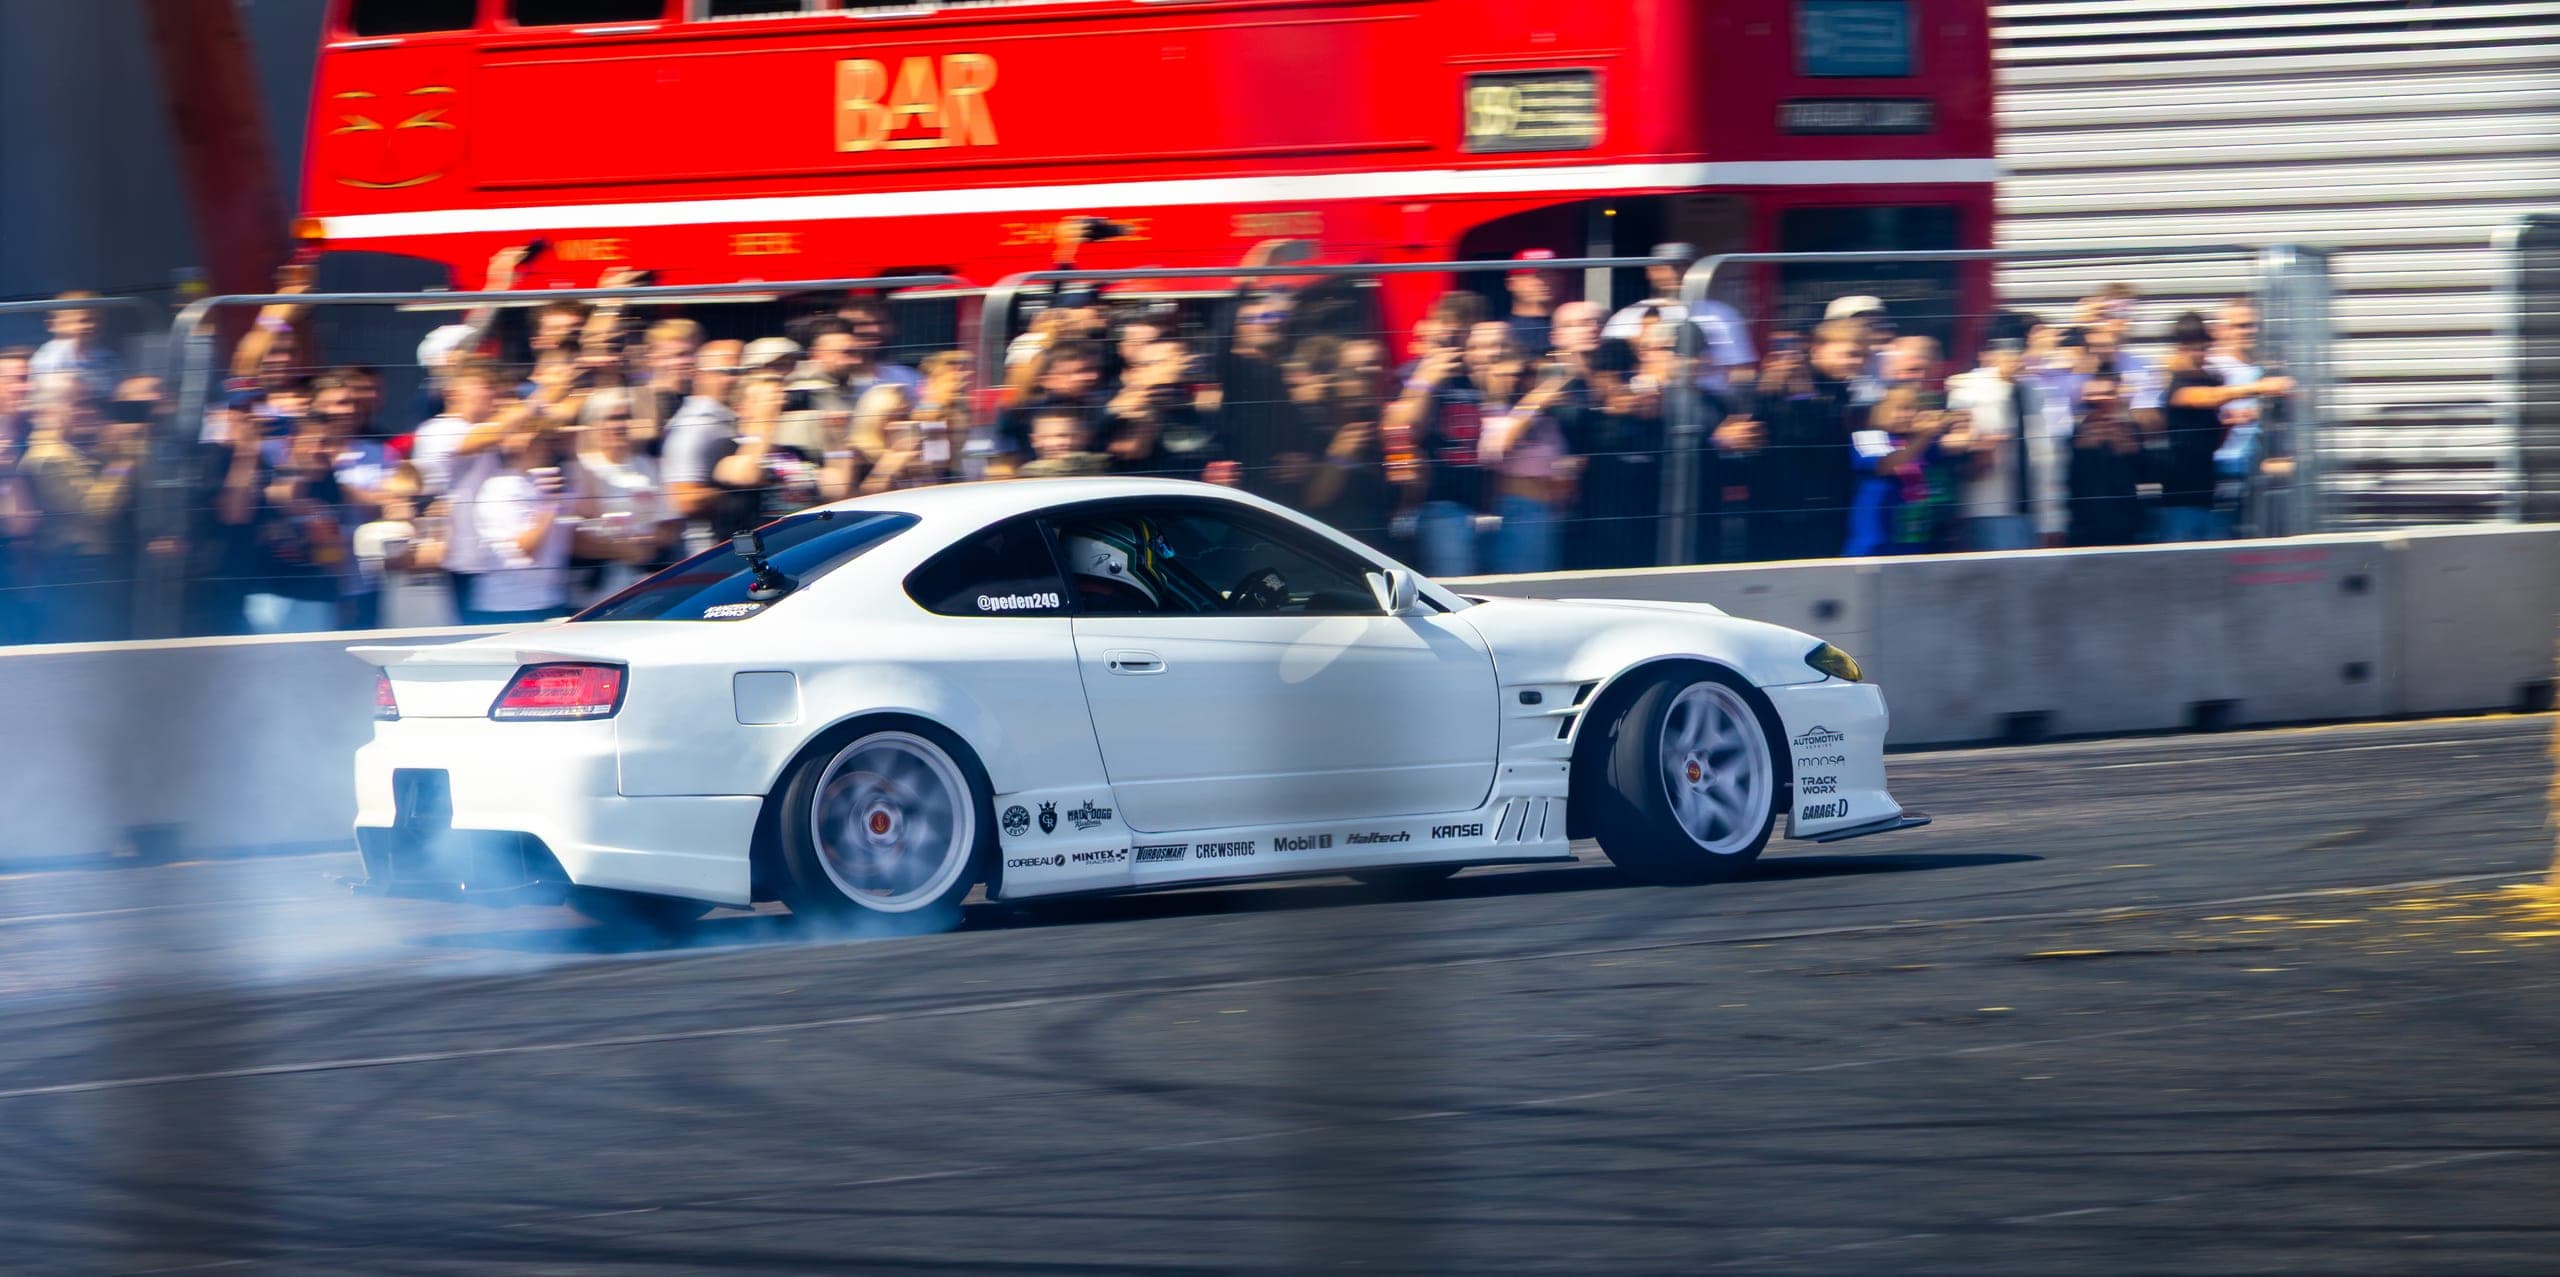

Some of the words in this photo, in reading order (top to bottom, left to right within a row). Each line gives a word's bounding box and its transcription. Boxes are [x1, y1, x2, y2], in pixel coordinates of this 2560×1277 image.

[835, 53, 998, 152] BAR
[977, 592, 1060, 611] @peden249
[1793, 733, 1845, 746] AUTOMOTIVE
[1801, 776, 1837, 785] TRACK
[1802, 785, 1836, 795] WORX
[1346, 831, 1411, 845] Haltech
[1432, 823, 1483, 839] KANSEI
[1274, 837, 1316, 852] Mobil
[1072, 849, 1114, 862] MINTEX
[1132, 844, 1188, 861] TURBOSMART
[1007, 857, 1054, 867] CORBEAU
